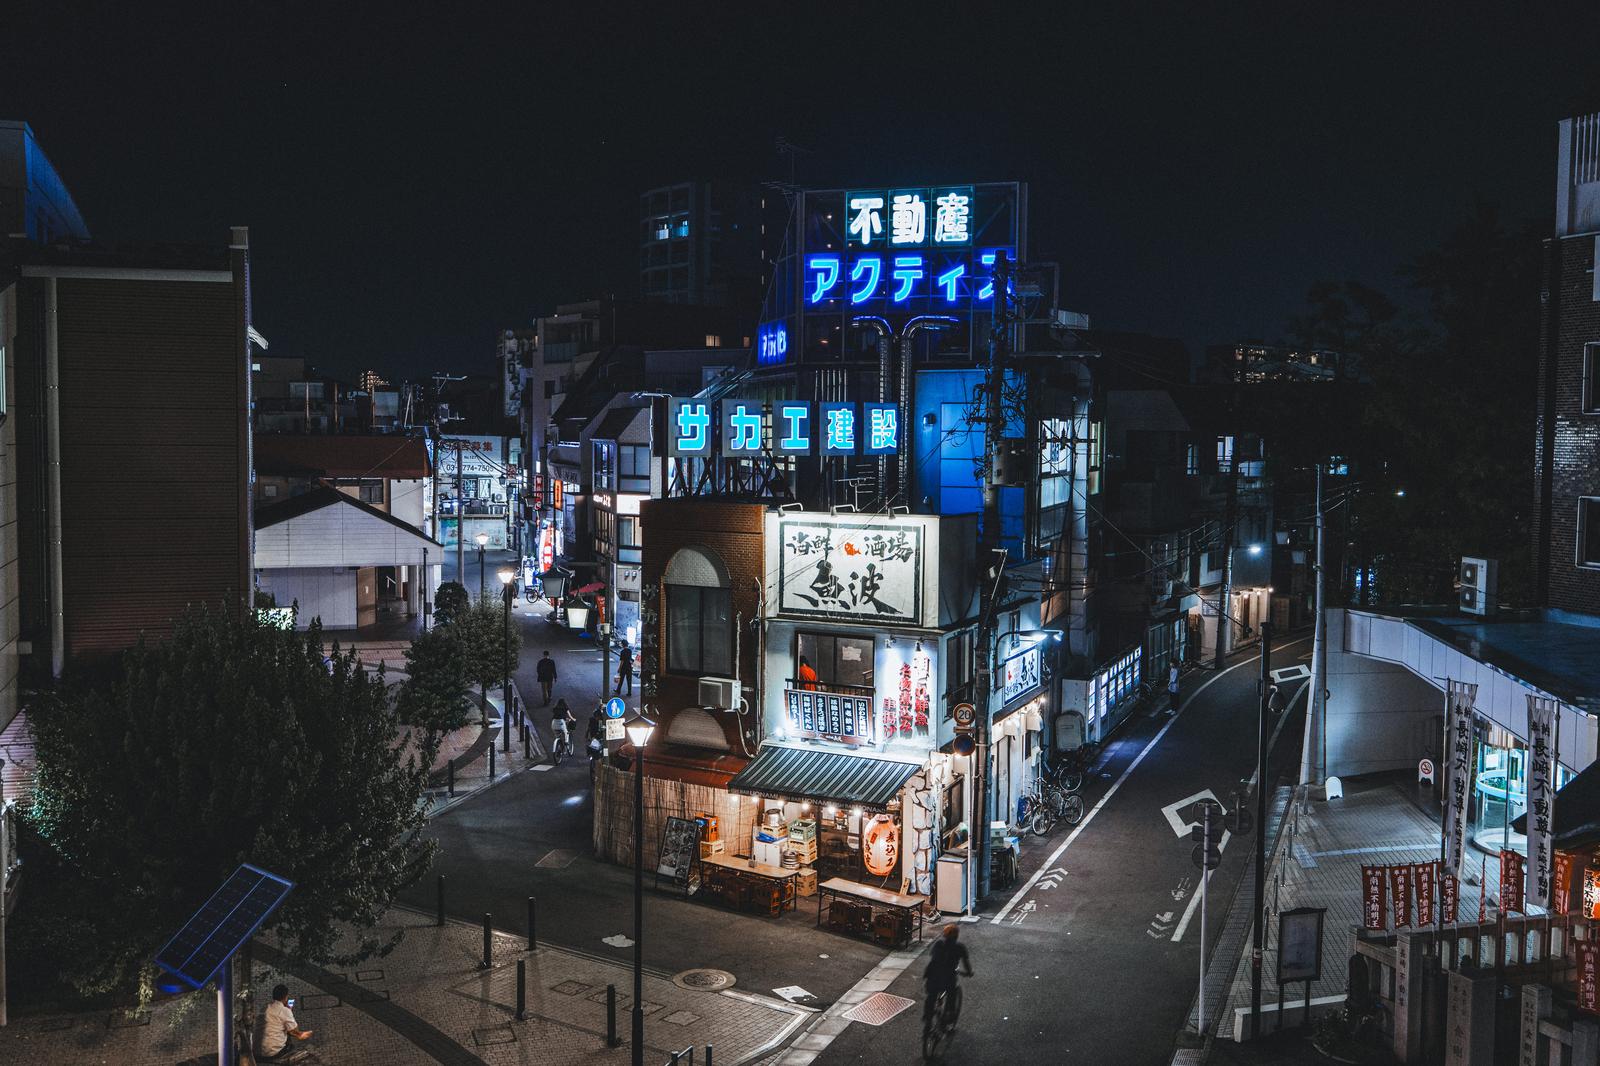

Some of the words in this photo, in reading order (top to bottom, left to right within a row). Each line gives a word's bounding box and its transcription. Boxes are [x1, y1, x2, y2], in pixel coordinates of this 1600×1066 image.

[850, 193, 969, 245] 不動産
[678, 404, 898, 450] サカエ建設
[786, 527, 834, 562] 海鮮
[864, 532, 914, 562] 酒場
[792, 560, 904, 613] 魚波
[958, 710, 971, 720] 20
